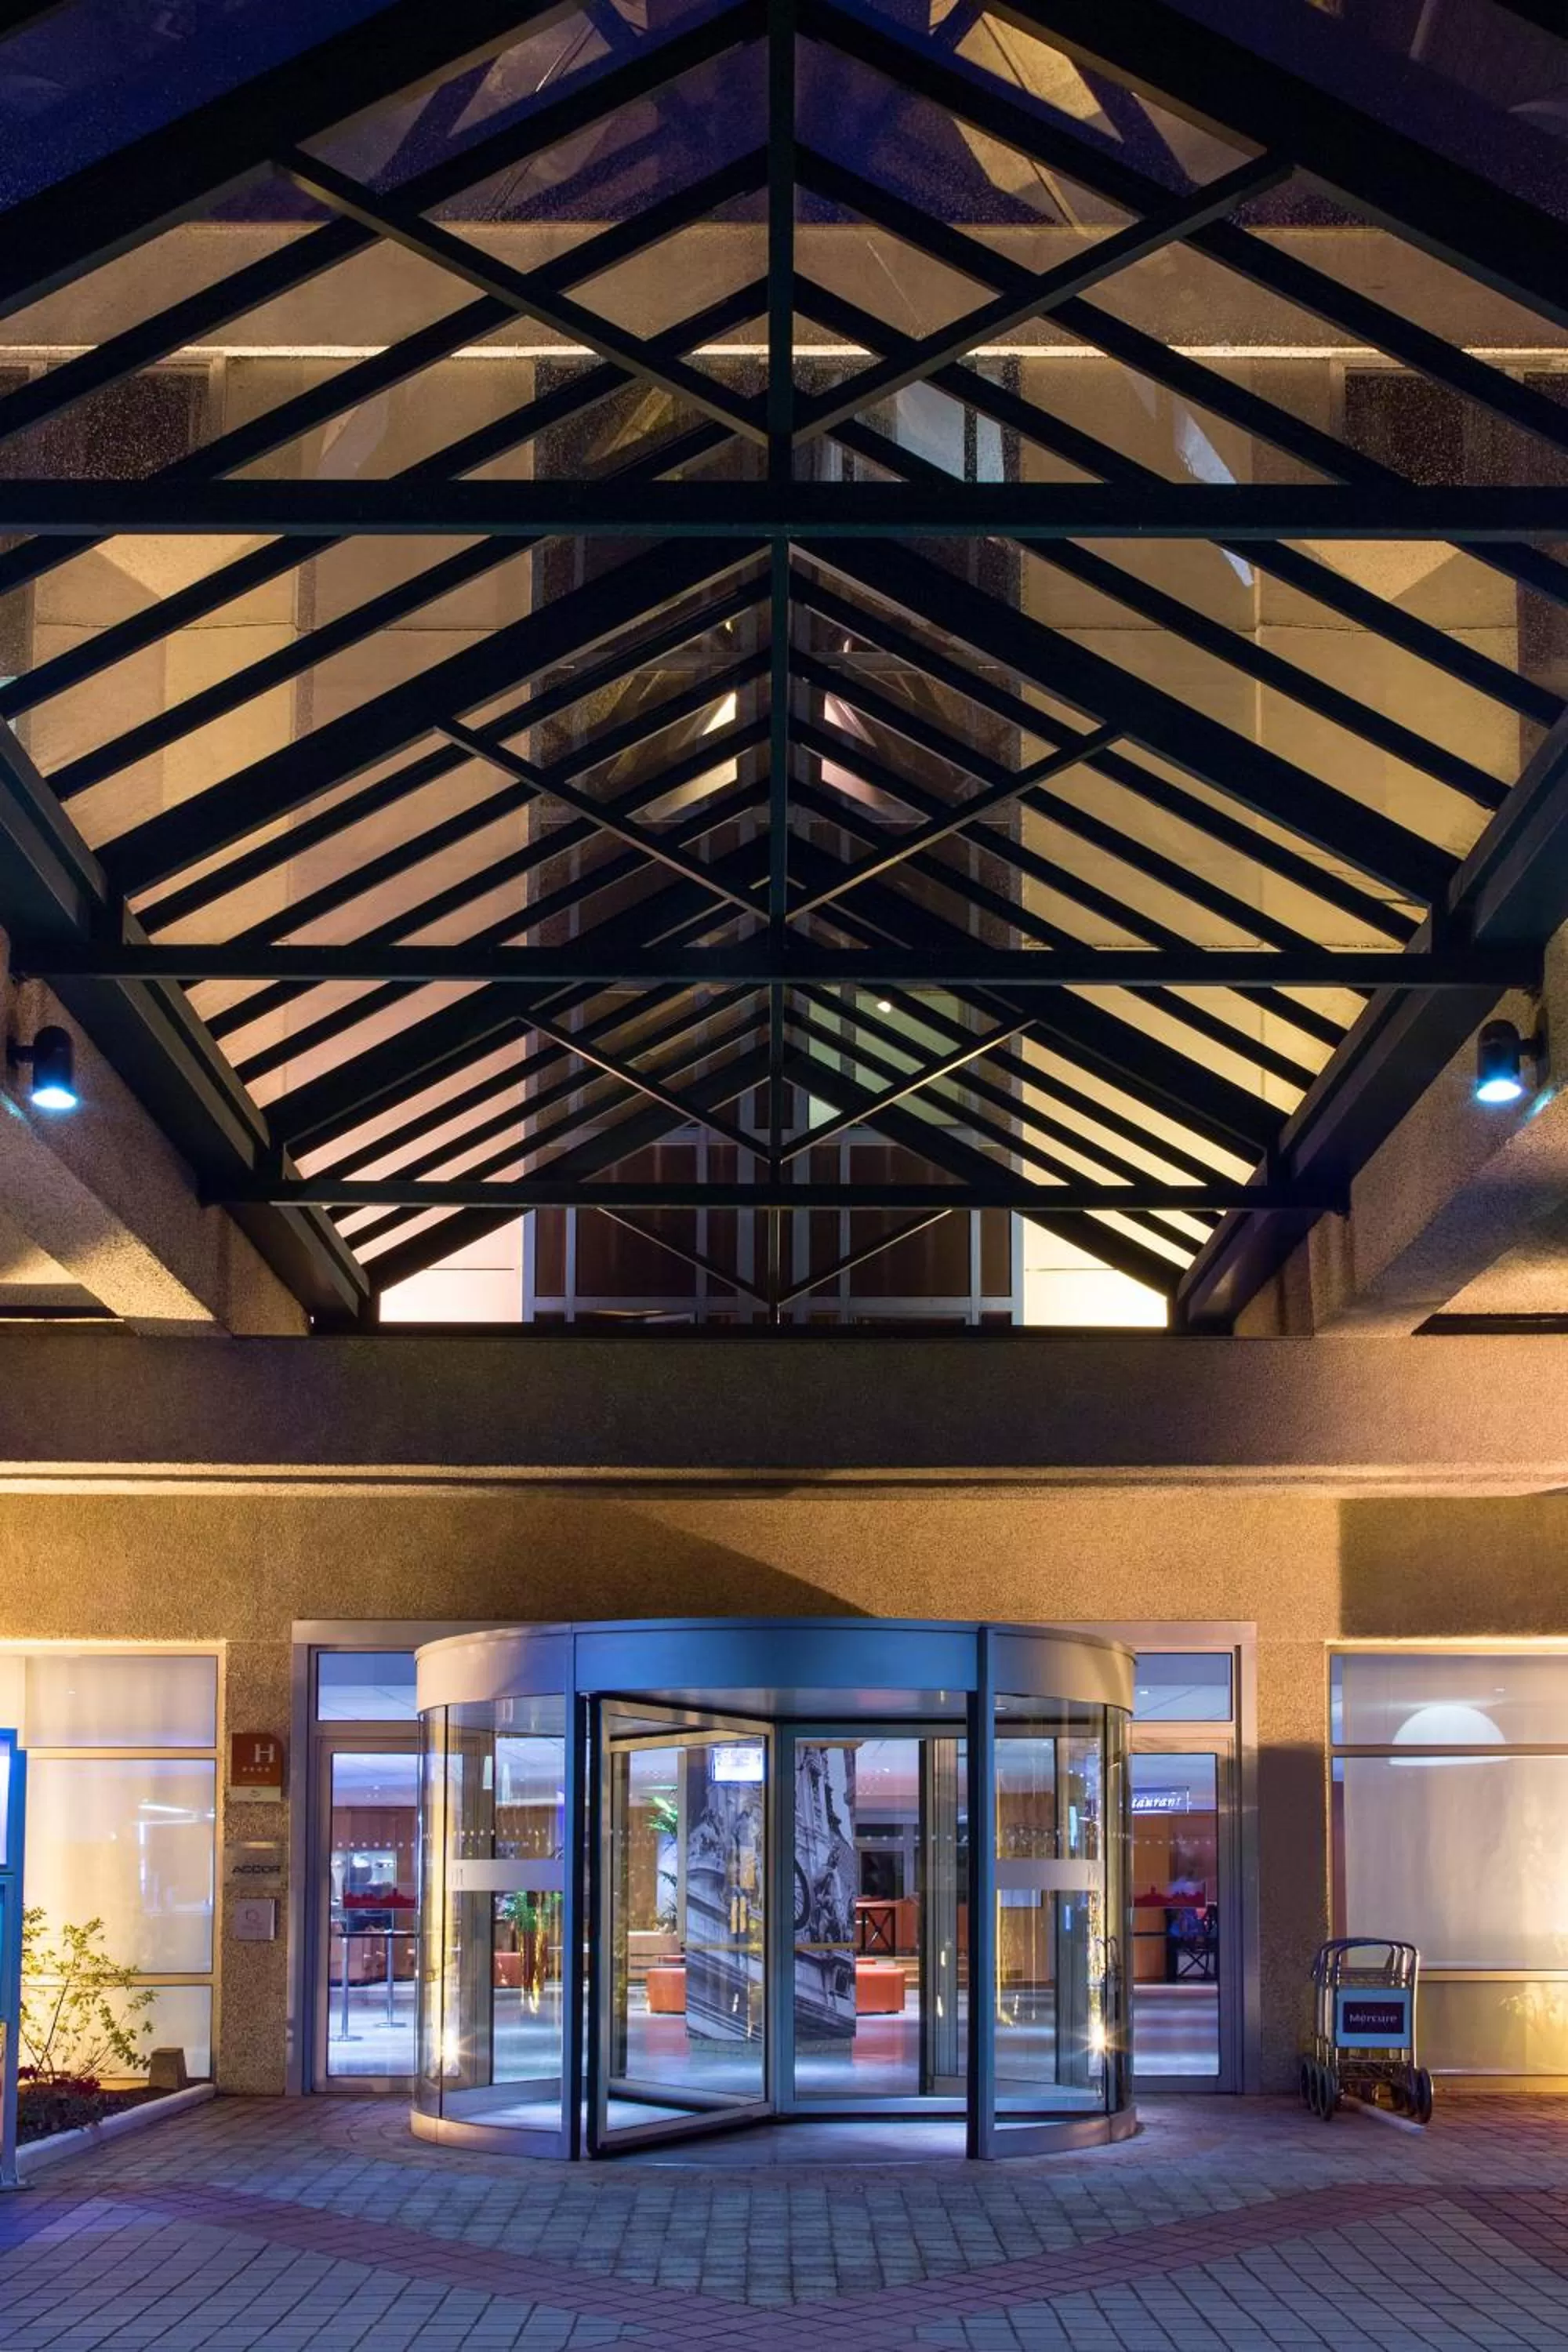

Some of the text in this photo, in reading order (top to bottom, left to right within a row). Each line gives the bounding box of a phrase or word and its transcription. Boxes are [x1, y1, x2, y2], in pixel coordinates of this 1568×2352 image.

[255, 1743, 274, 1763] H
[1131, 1796, 1181, 1808] taurant
[232, 1864, 281, 1875] ACCOR
[1348, 2013, 1397, 2024] Mercure
